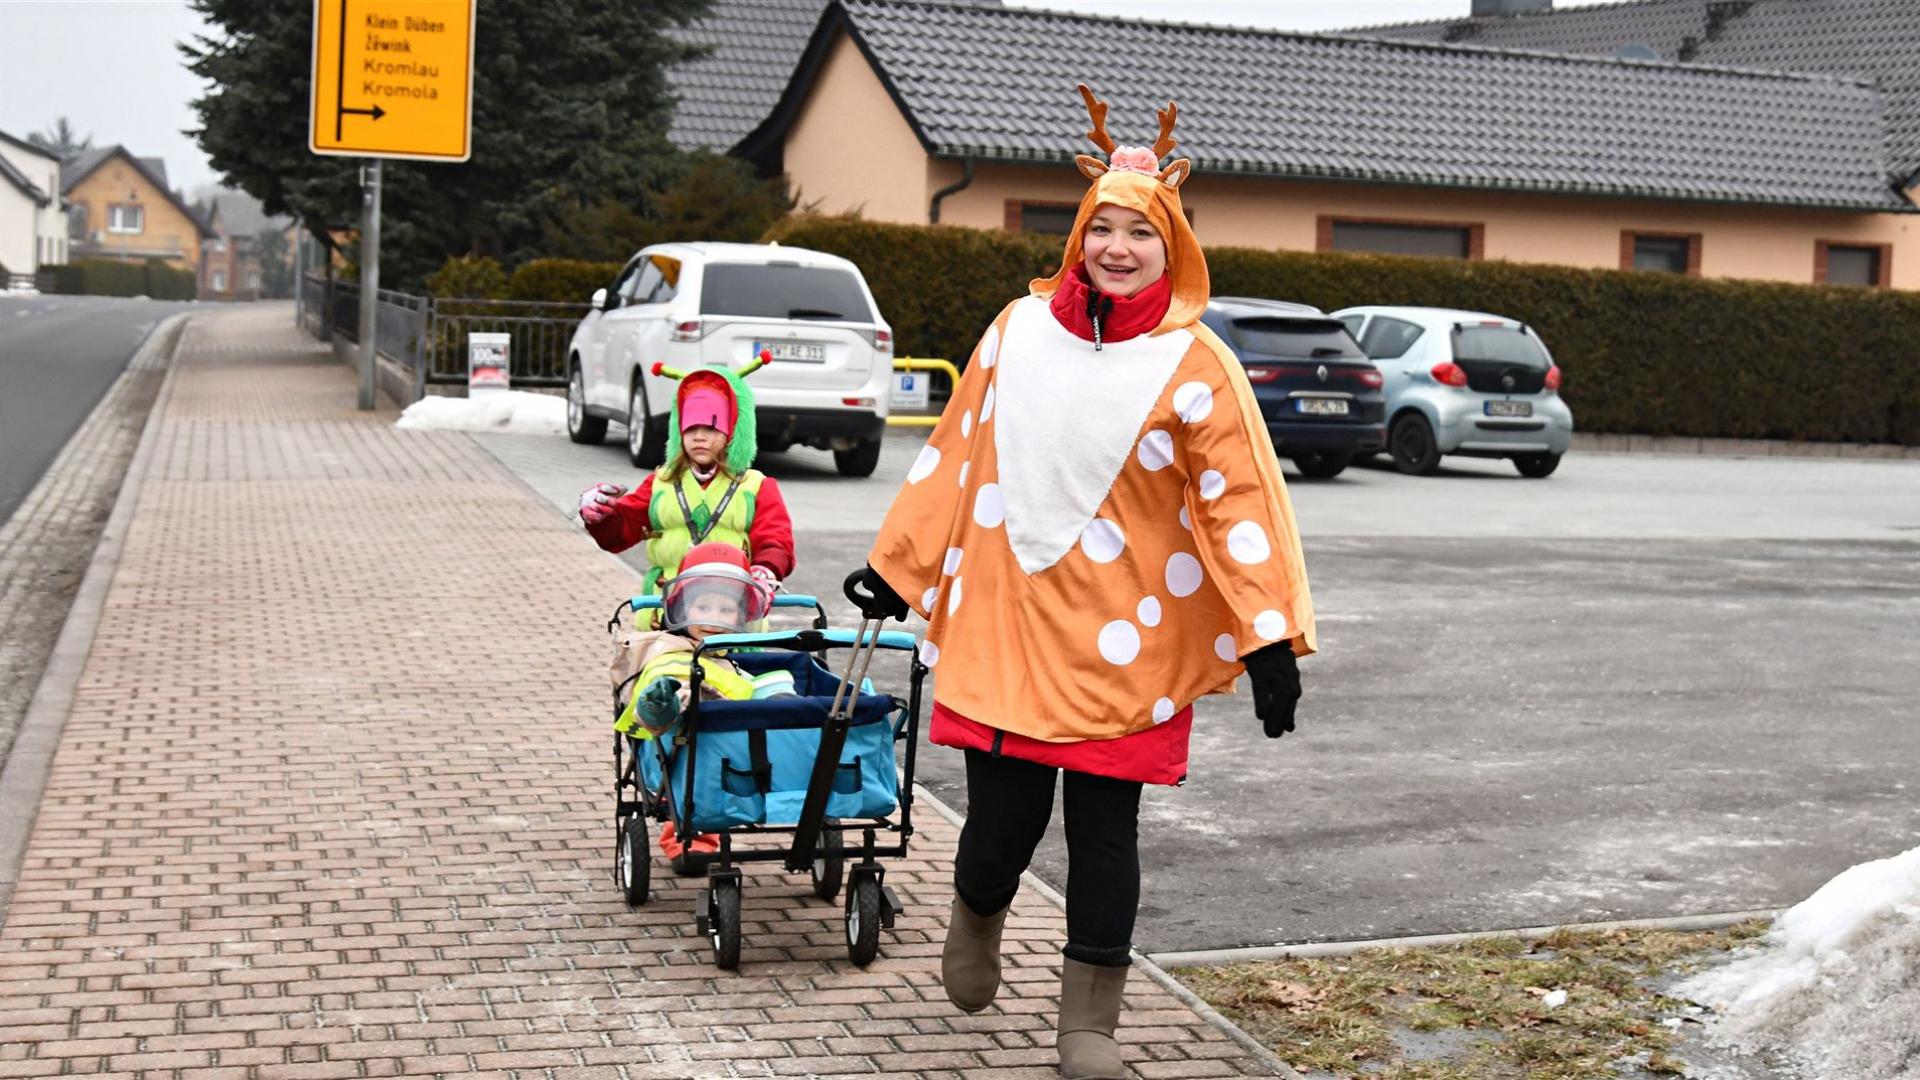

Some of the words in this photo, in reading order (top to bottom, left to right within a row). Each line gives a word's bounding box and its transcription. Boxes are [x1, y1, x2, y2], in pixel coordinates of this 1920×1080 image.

[366, 13, 398, 29] Klein
[405, 15, 445, 32] Düben
[363, 58, 438, 77] Kromlau
[362, 81, 438, 99] Kromola
[805, 346, 824, 359] 311
